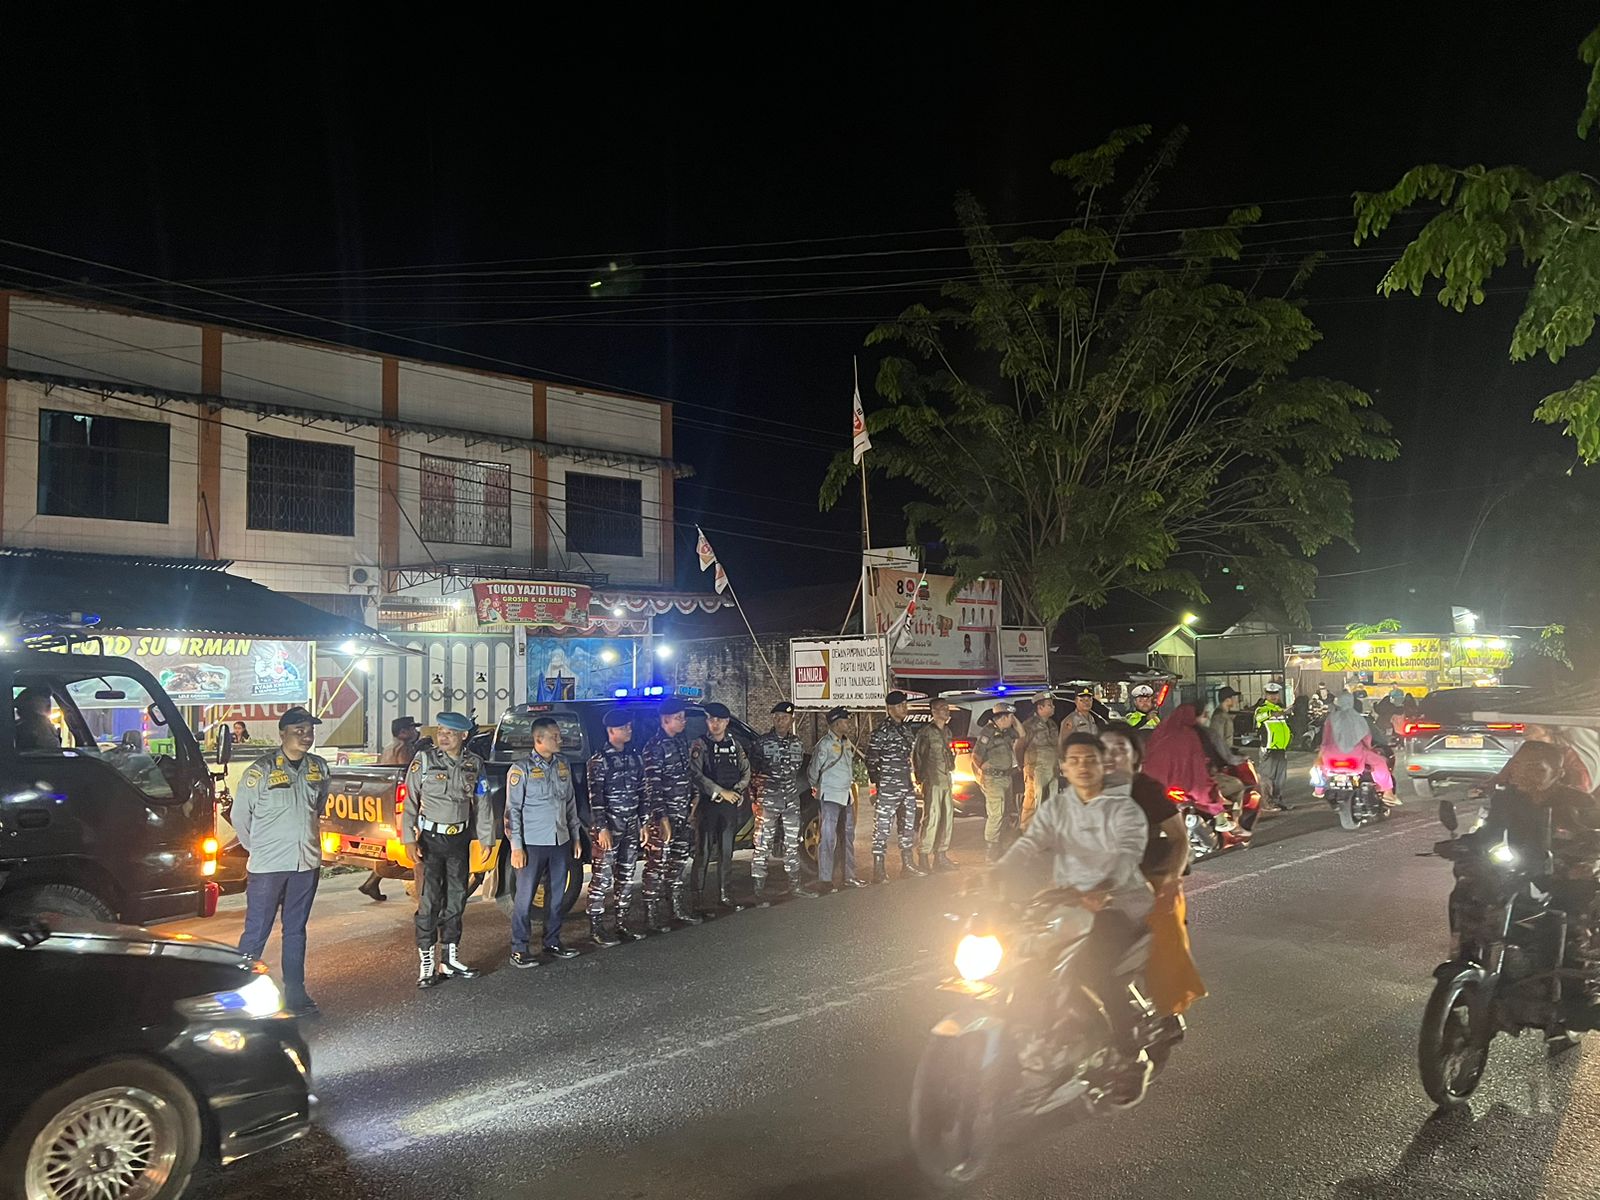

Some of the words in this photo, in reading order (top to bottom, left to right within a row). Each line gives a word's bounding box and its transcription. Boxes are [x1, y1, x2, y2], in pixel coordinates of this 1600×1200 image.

[486, 584, 515, 595] TOKO
[517, 585, 547, 595] YAZID
[548, 587, 577, 598] LUBIS
[897, 580, 904, 595] 8
[1351, 657, 1372, 668] Ayam
[1373, 657, 1399, 668] Penyet
[1400, 656, 1440, 667] Lamongan
[798, 667, 823, 682] HANURA
[325, 793, 384, 823] POLISI
